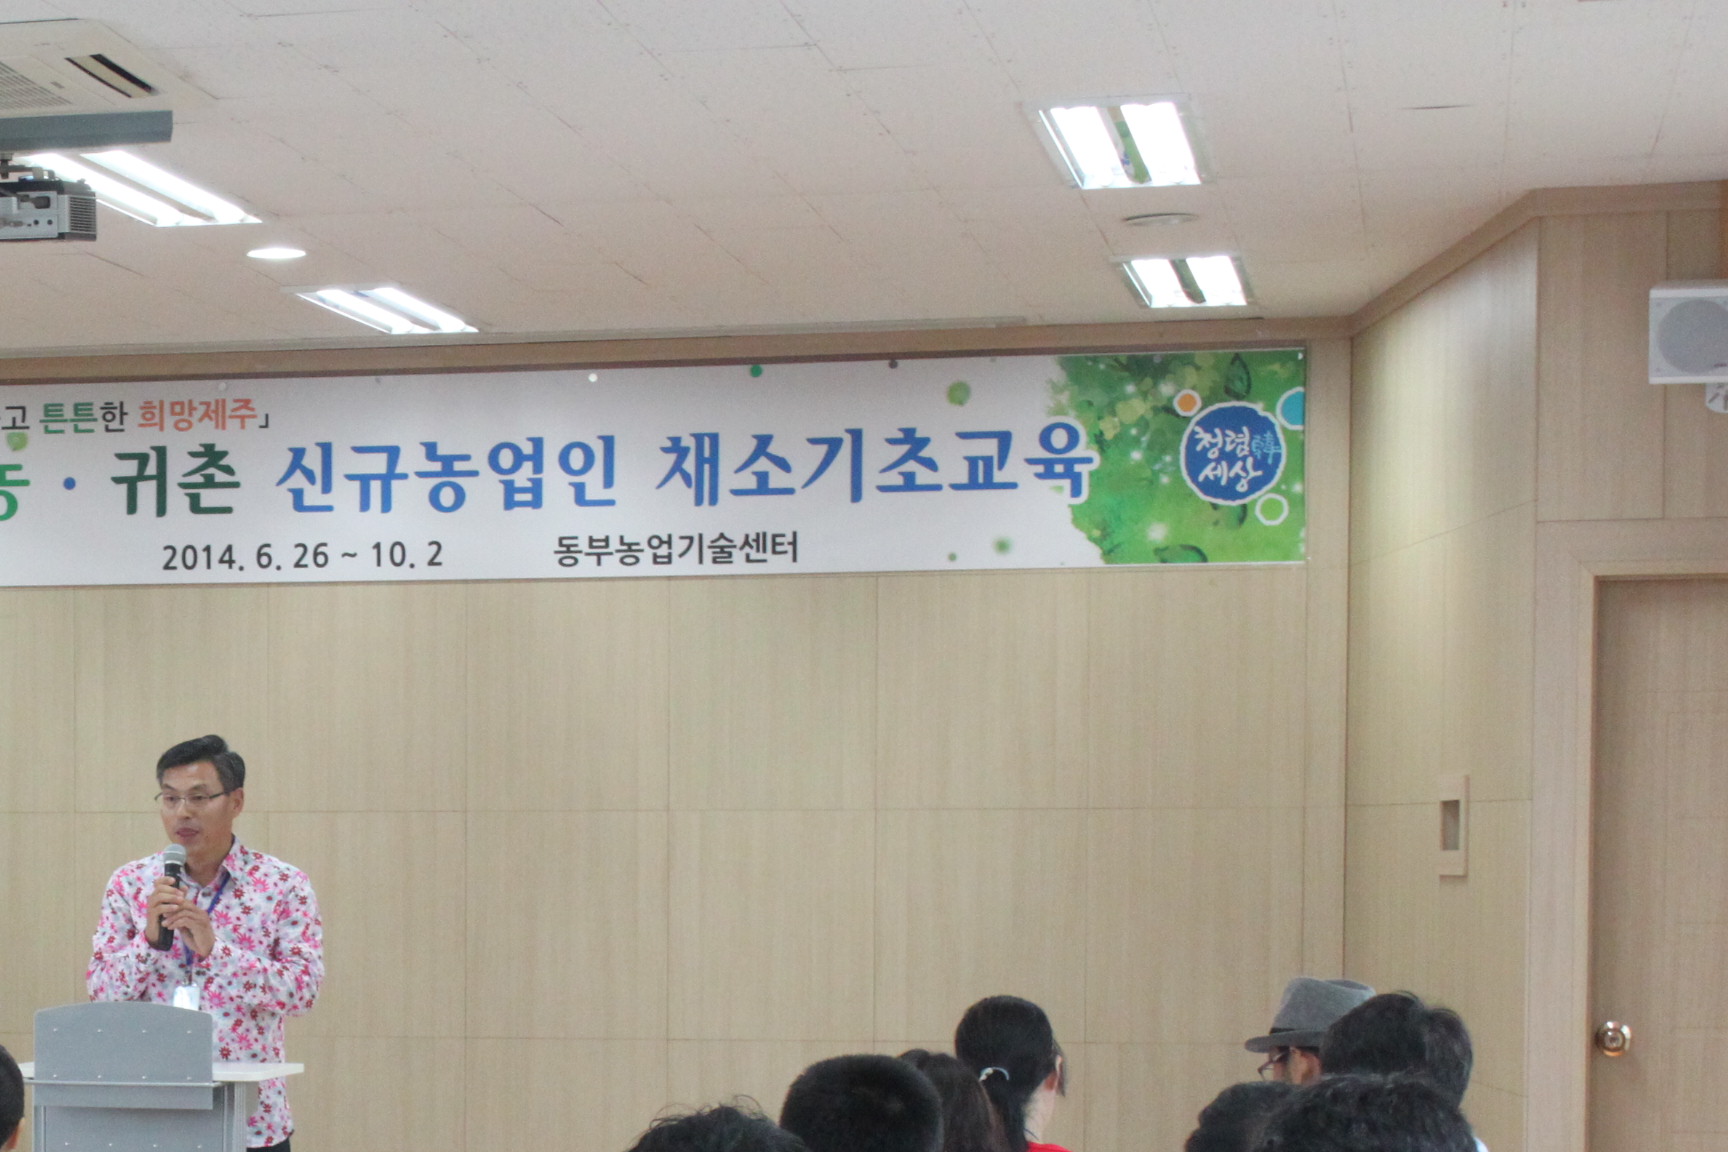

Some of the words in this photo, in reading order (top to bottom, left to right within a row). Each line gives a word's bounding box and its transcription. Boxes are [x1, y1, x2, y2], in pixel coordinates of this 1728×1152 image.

[39, 401, 128, 435] 튼튼한
[110, 443, 242, 518] 귀촌
[274, 434, 617, 514] 신규농업인
[655, 421, 1095, 507] 채소기초교육
[1197, 456, 1264, 493] 세상
[553, 531, 799, 568] 동부농업기술센터
